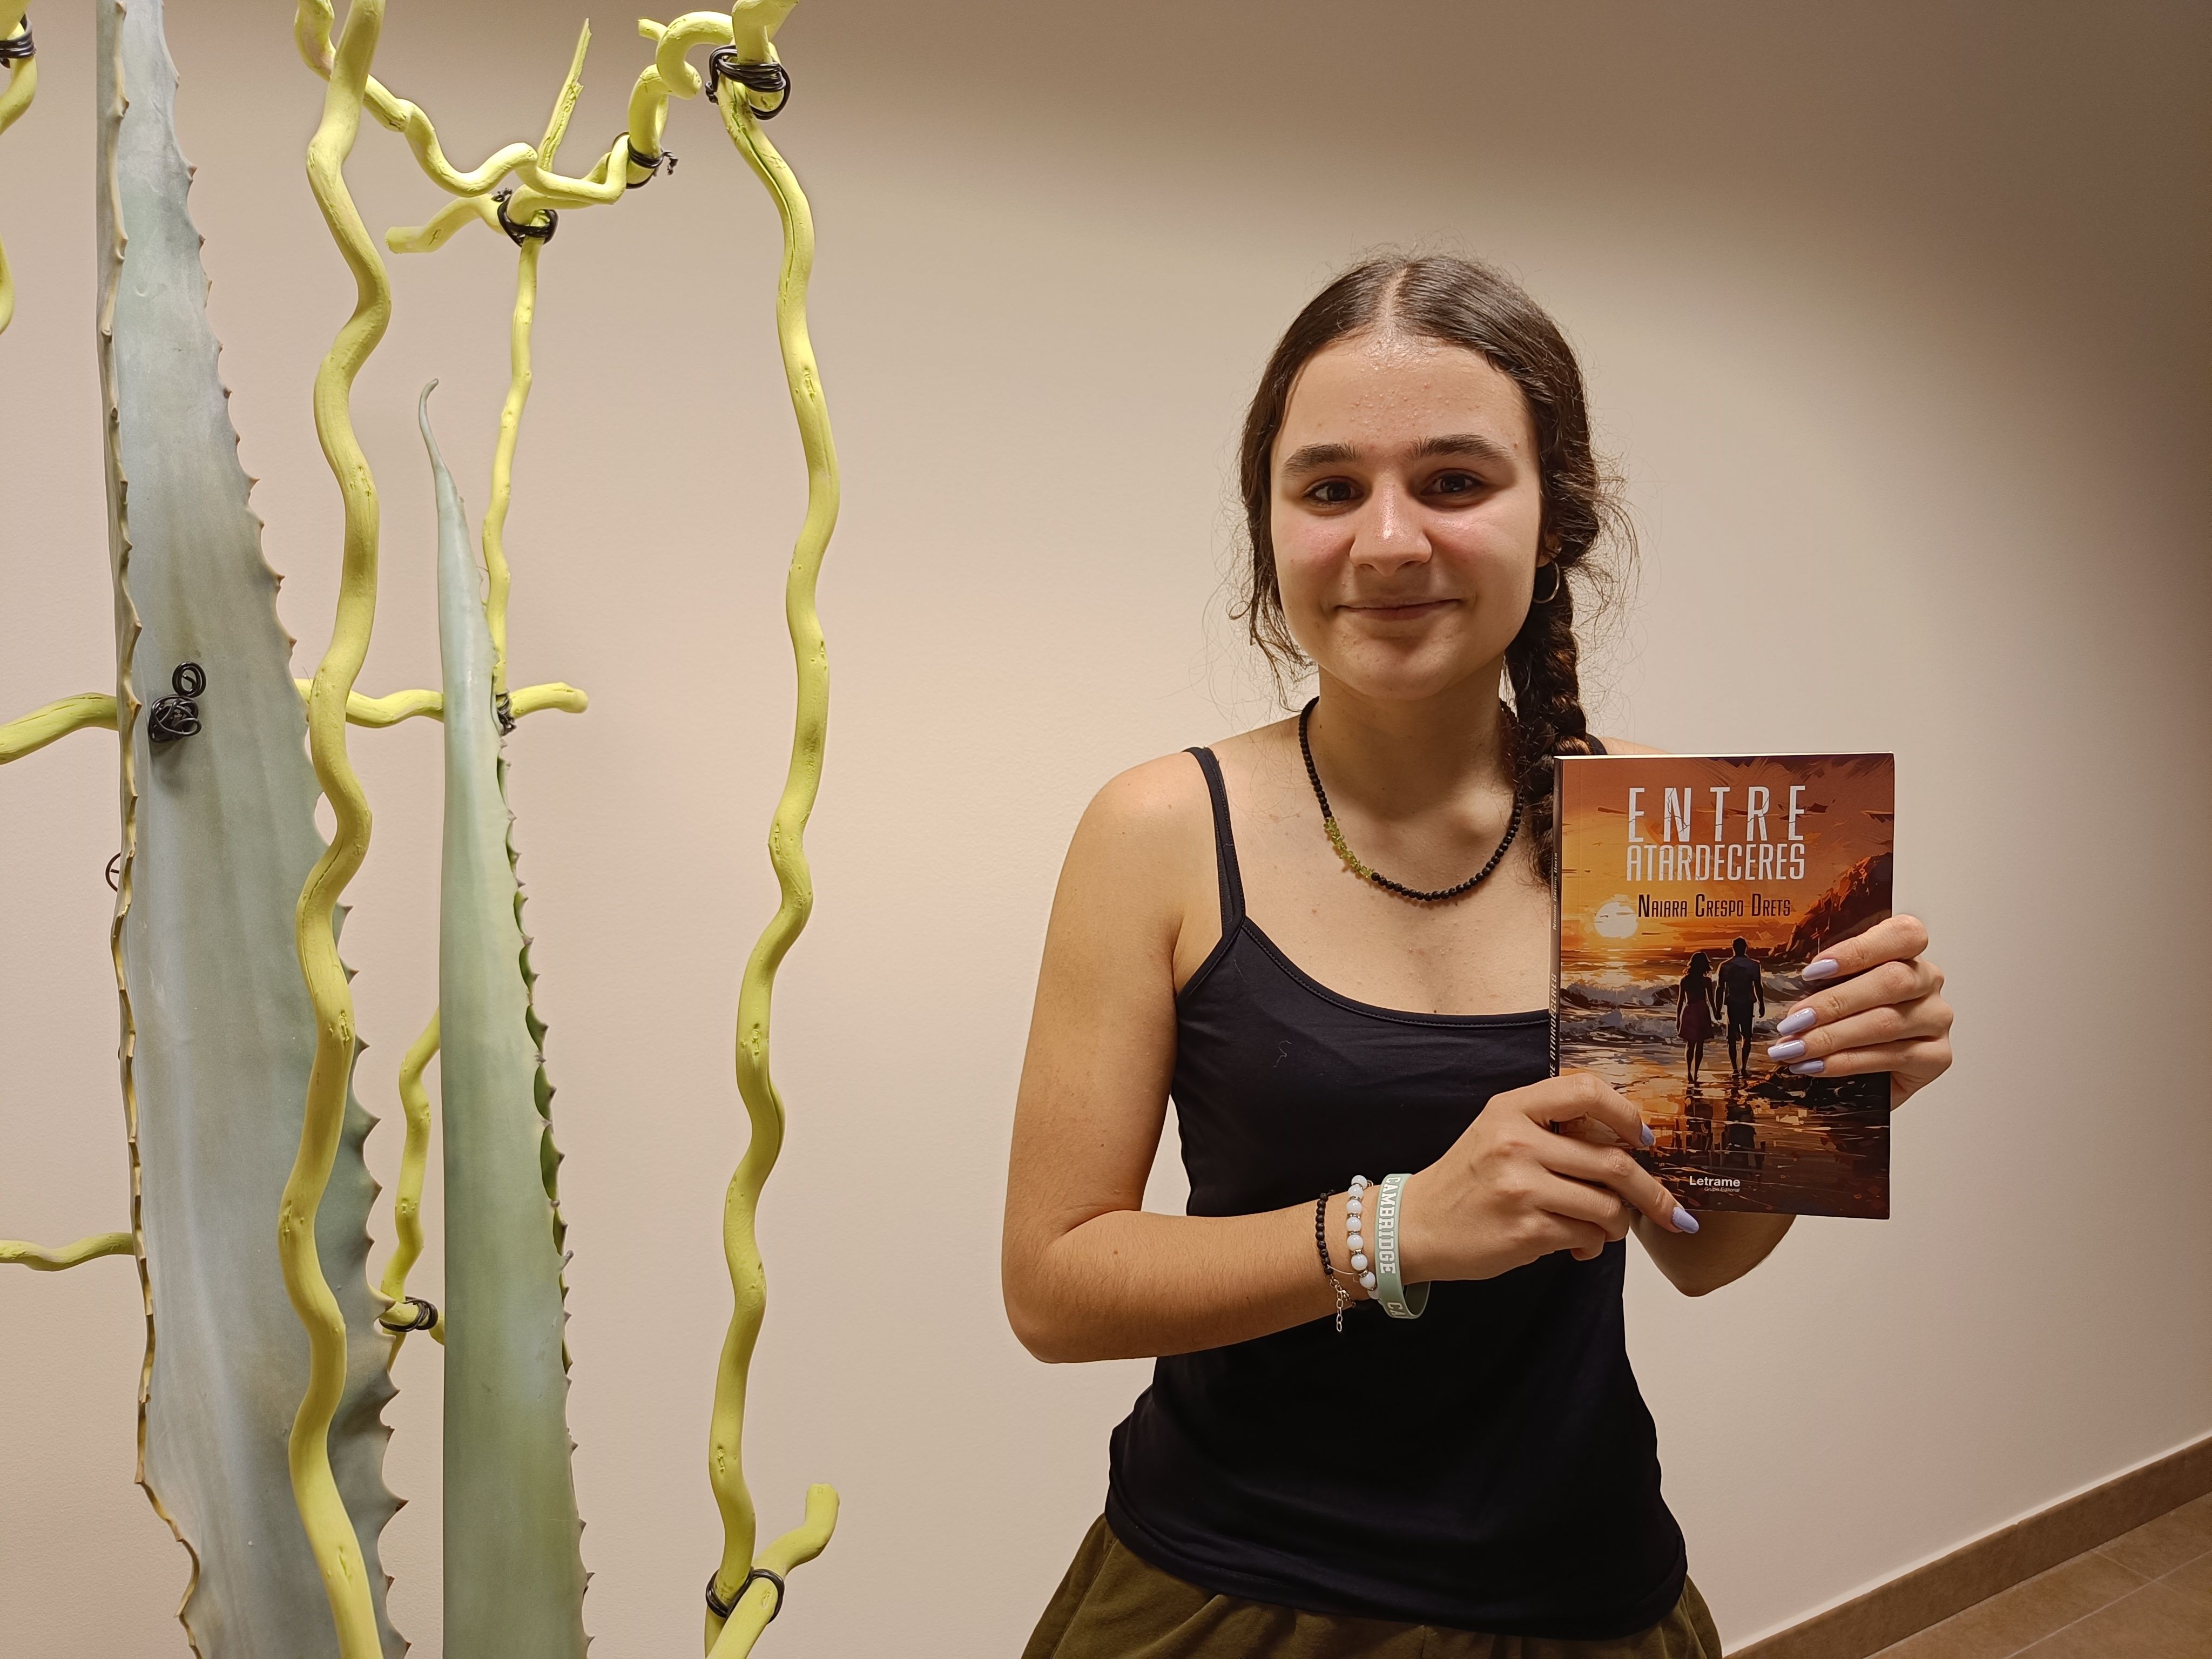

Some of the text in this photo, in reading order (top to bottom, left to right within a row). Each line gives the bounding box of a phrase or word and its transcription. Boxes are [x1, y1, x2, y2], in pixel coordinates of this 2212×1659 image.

[1628, 785, 1806, 842] ENTRE
[1626, 843, 1805, 881] ATARDECERES
[1689, 1176, 1741, 1187] Letrame
[1378, 1176, 1401, 1274] CAMBRIDGE
